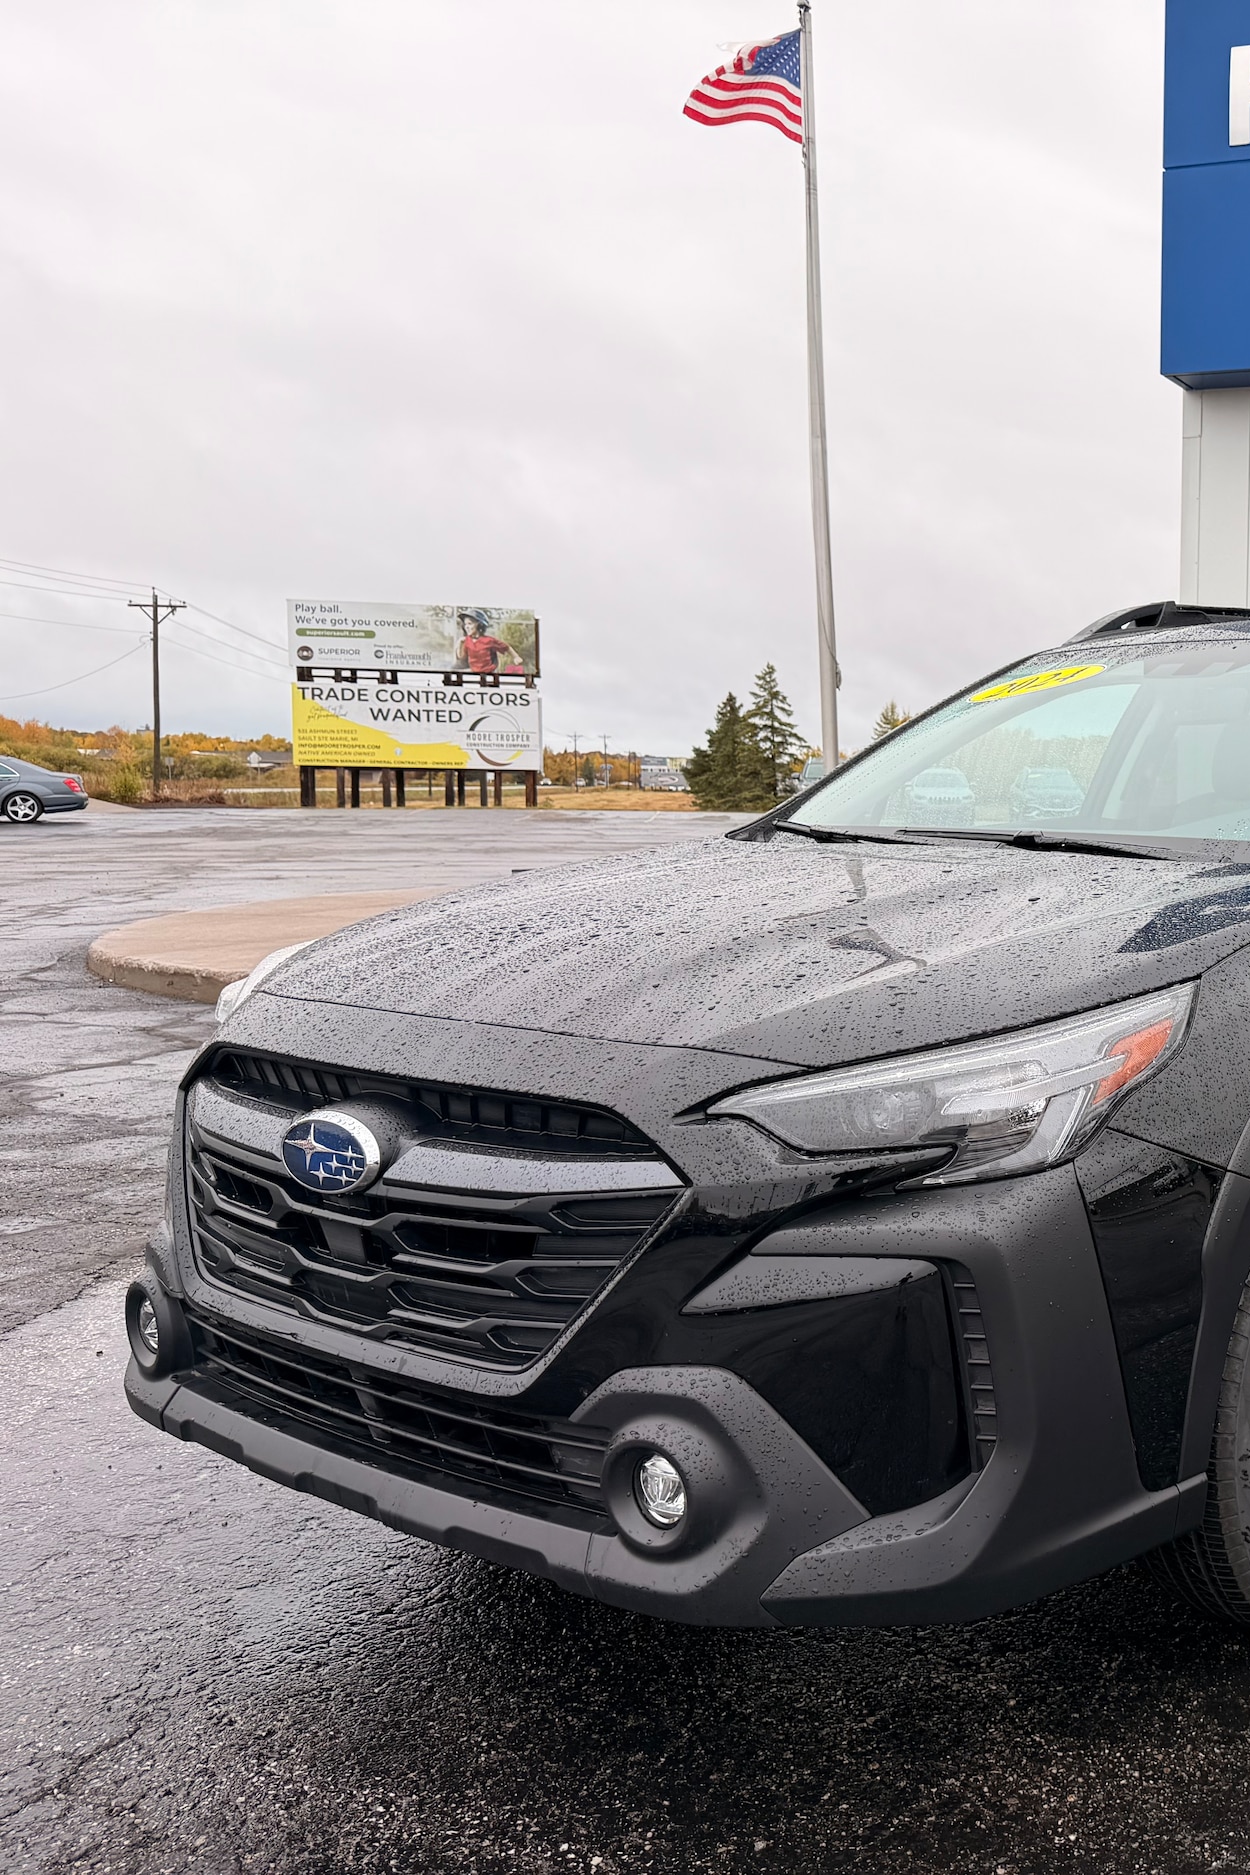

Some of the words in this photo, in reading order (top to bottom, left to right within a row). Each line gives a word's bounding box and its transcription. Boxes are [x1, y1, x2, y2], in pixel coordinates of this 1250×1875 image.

[295, 604, 316, 614] Play
[320, 604, 342, 614] ball.
[295, 616, 327, 624] We've
[330, 617, 348, 626] got
[352, 618, 370, 628] you
[374, 619, 418, 628] covered.
[318, 647, 360, 656] SUPERIOR
[297, 686, 369, 702] TRADE
[376, 689, 530, 706] CONTRACTORS
[370, 707, 462, 722] WANTED
[496, 734, 530, 742] TROSPER
